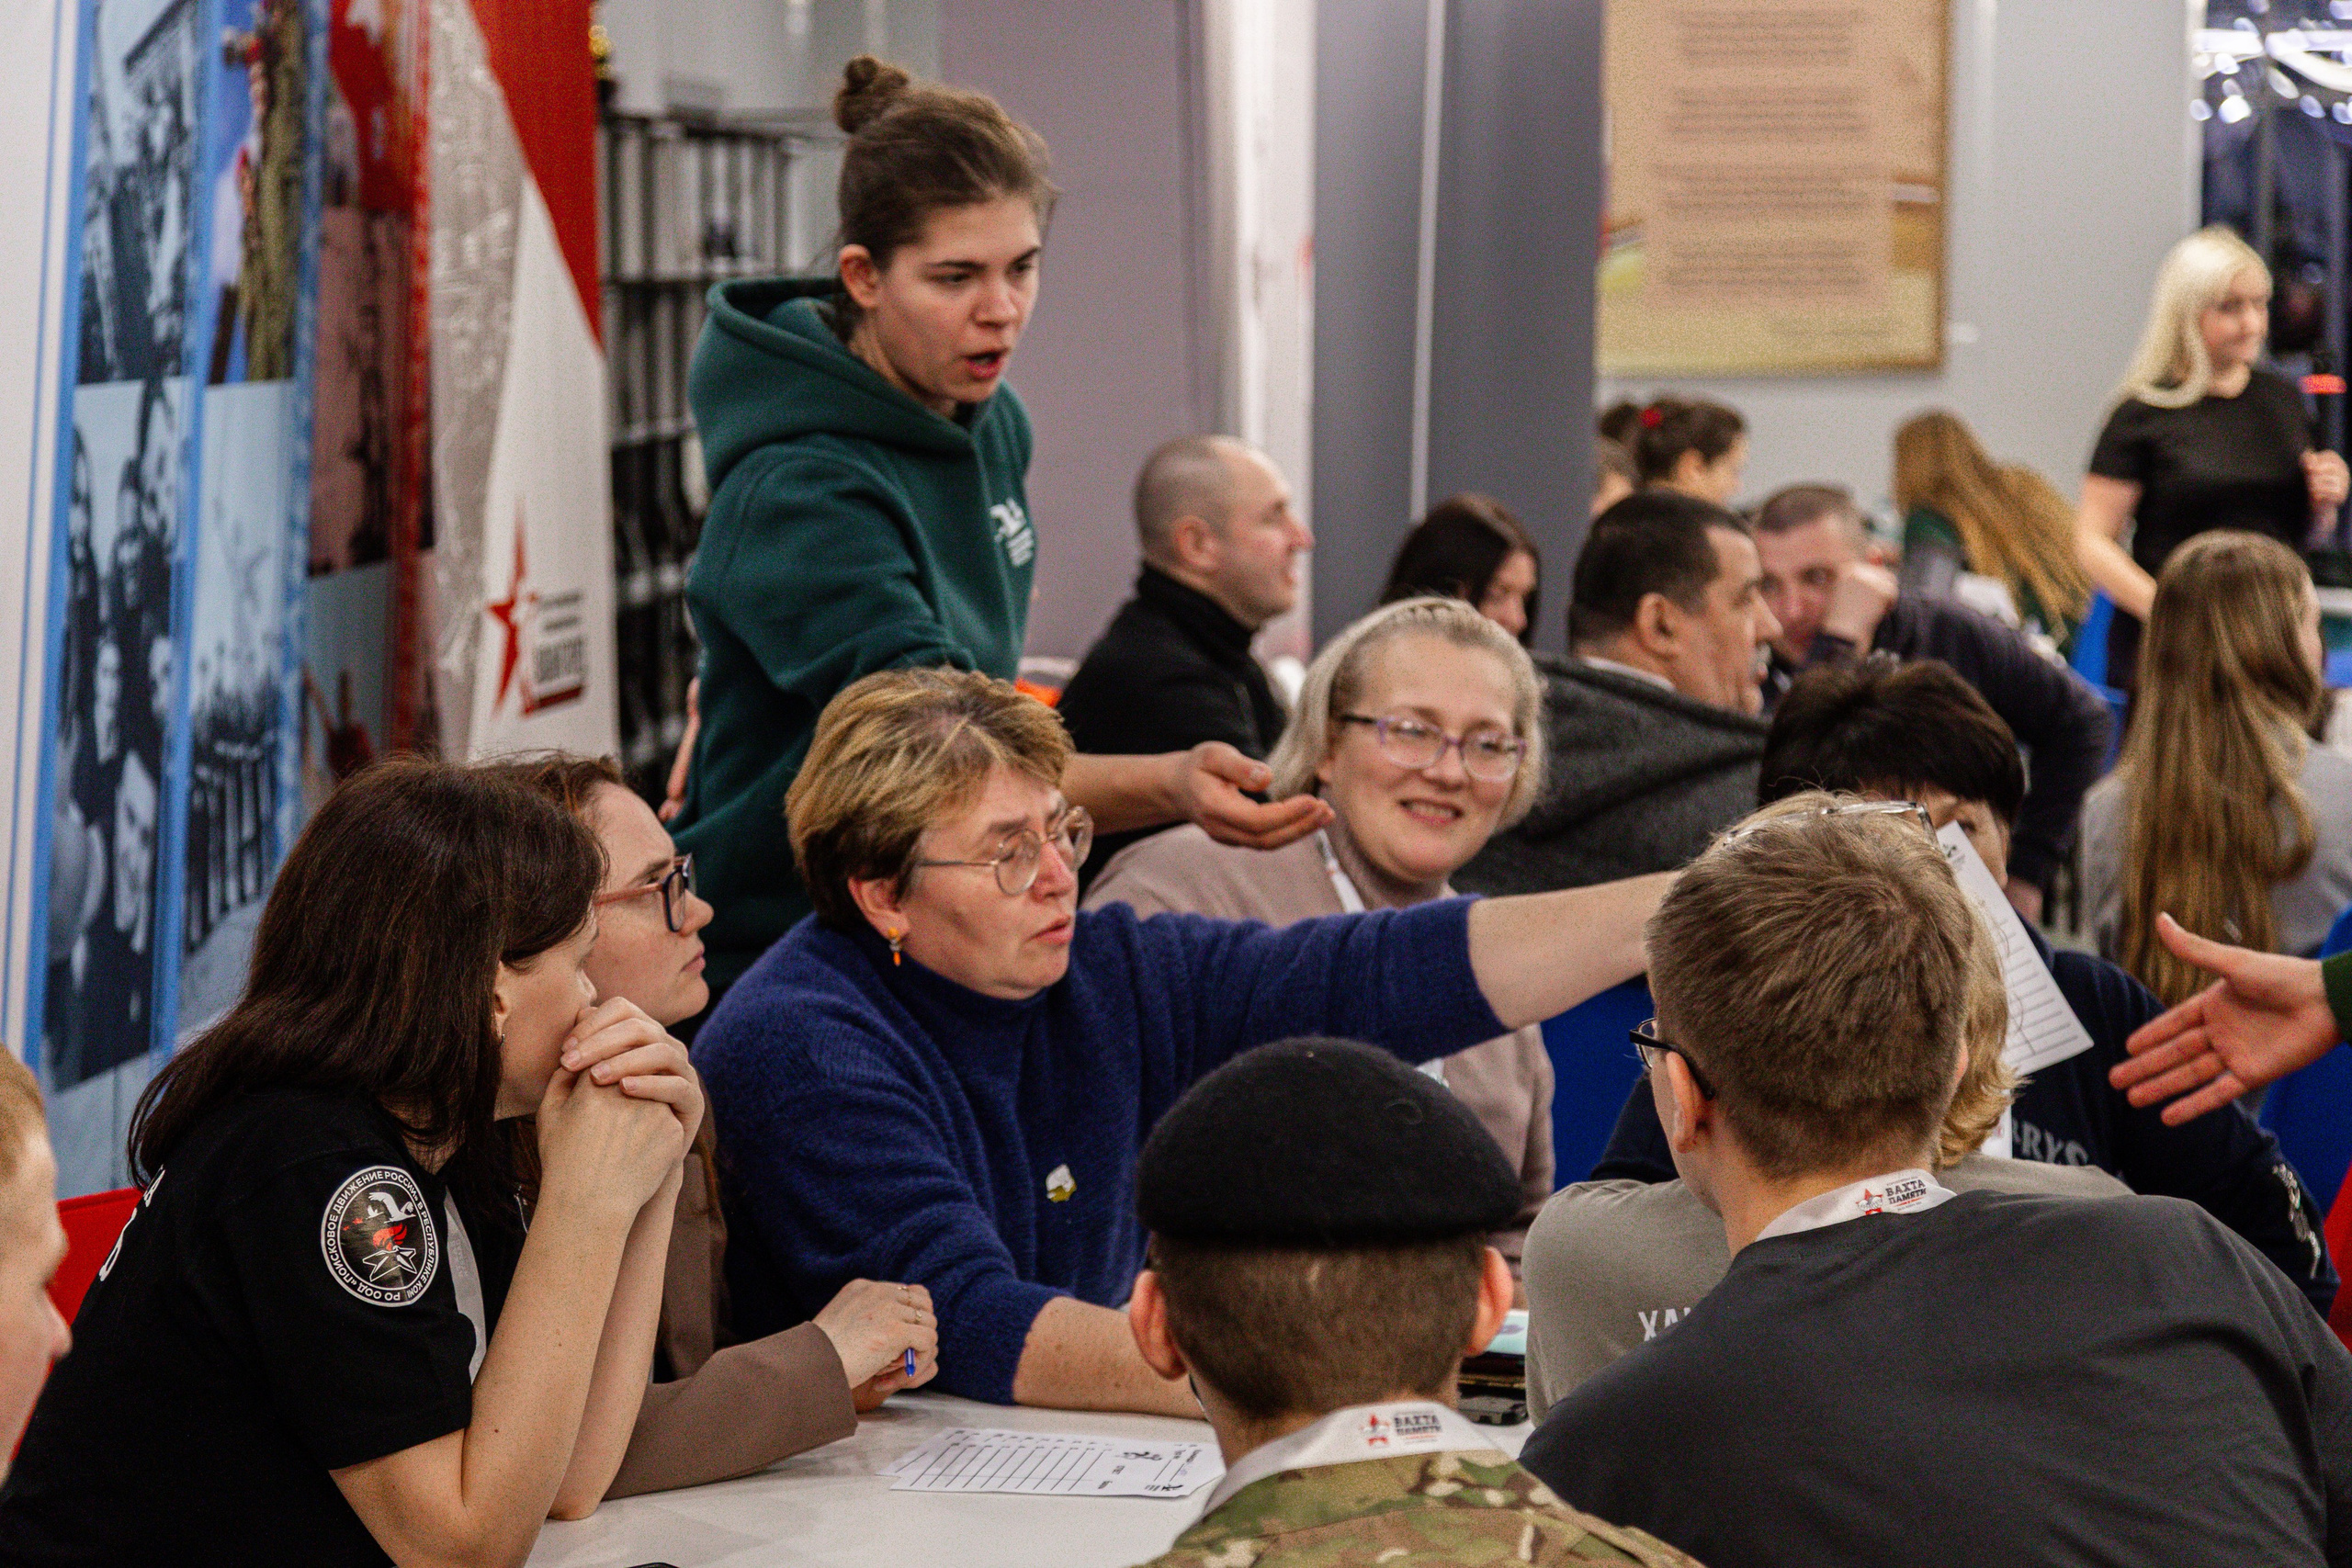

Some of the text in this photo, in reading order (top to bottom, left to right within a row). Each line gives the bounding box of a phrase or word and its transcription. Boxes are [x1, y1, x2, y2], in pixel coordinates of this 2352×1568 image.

[333, 1170, 384, 1214] ДВИЖЕНИЕ
[1885, 1179, 1926, 1197] ВАХТА
[1888, 1188, 1927, 1204] ПАМЯТИ
[416, 1201, 424, 1211] В
[326, 1214, 357, 1286] «ПОИСКОВОЕ
[421, 1212, 435, 1284] РЕСПУБЛИКЕ
[356, 1281, 382, 1300] ООД
[384, 1292, 401, 1302] РО
[1394, 1415, 1440, 1428] ВАХТА
